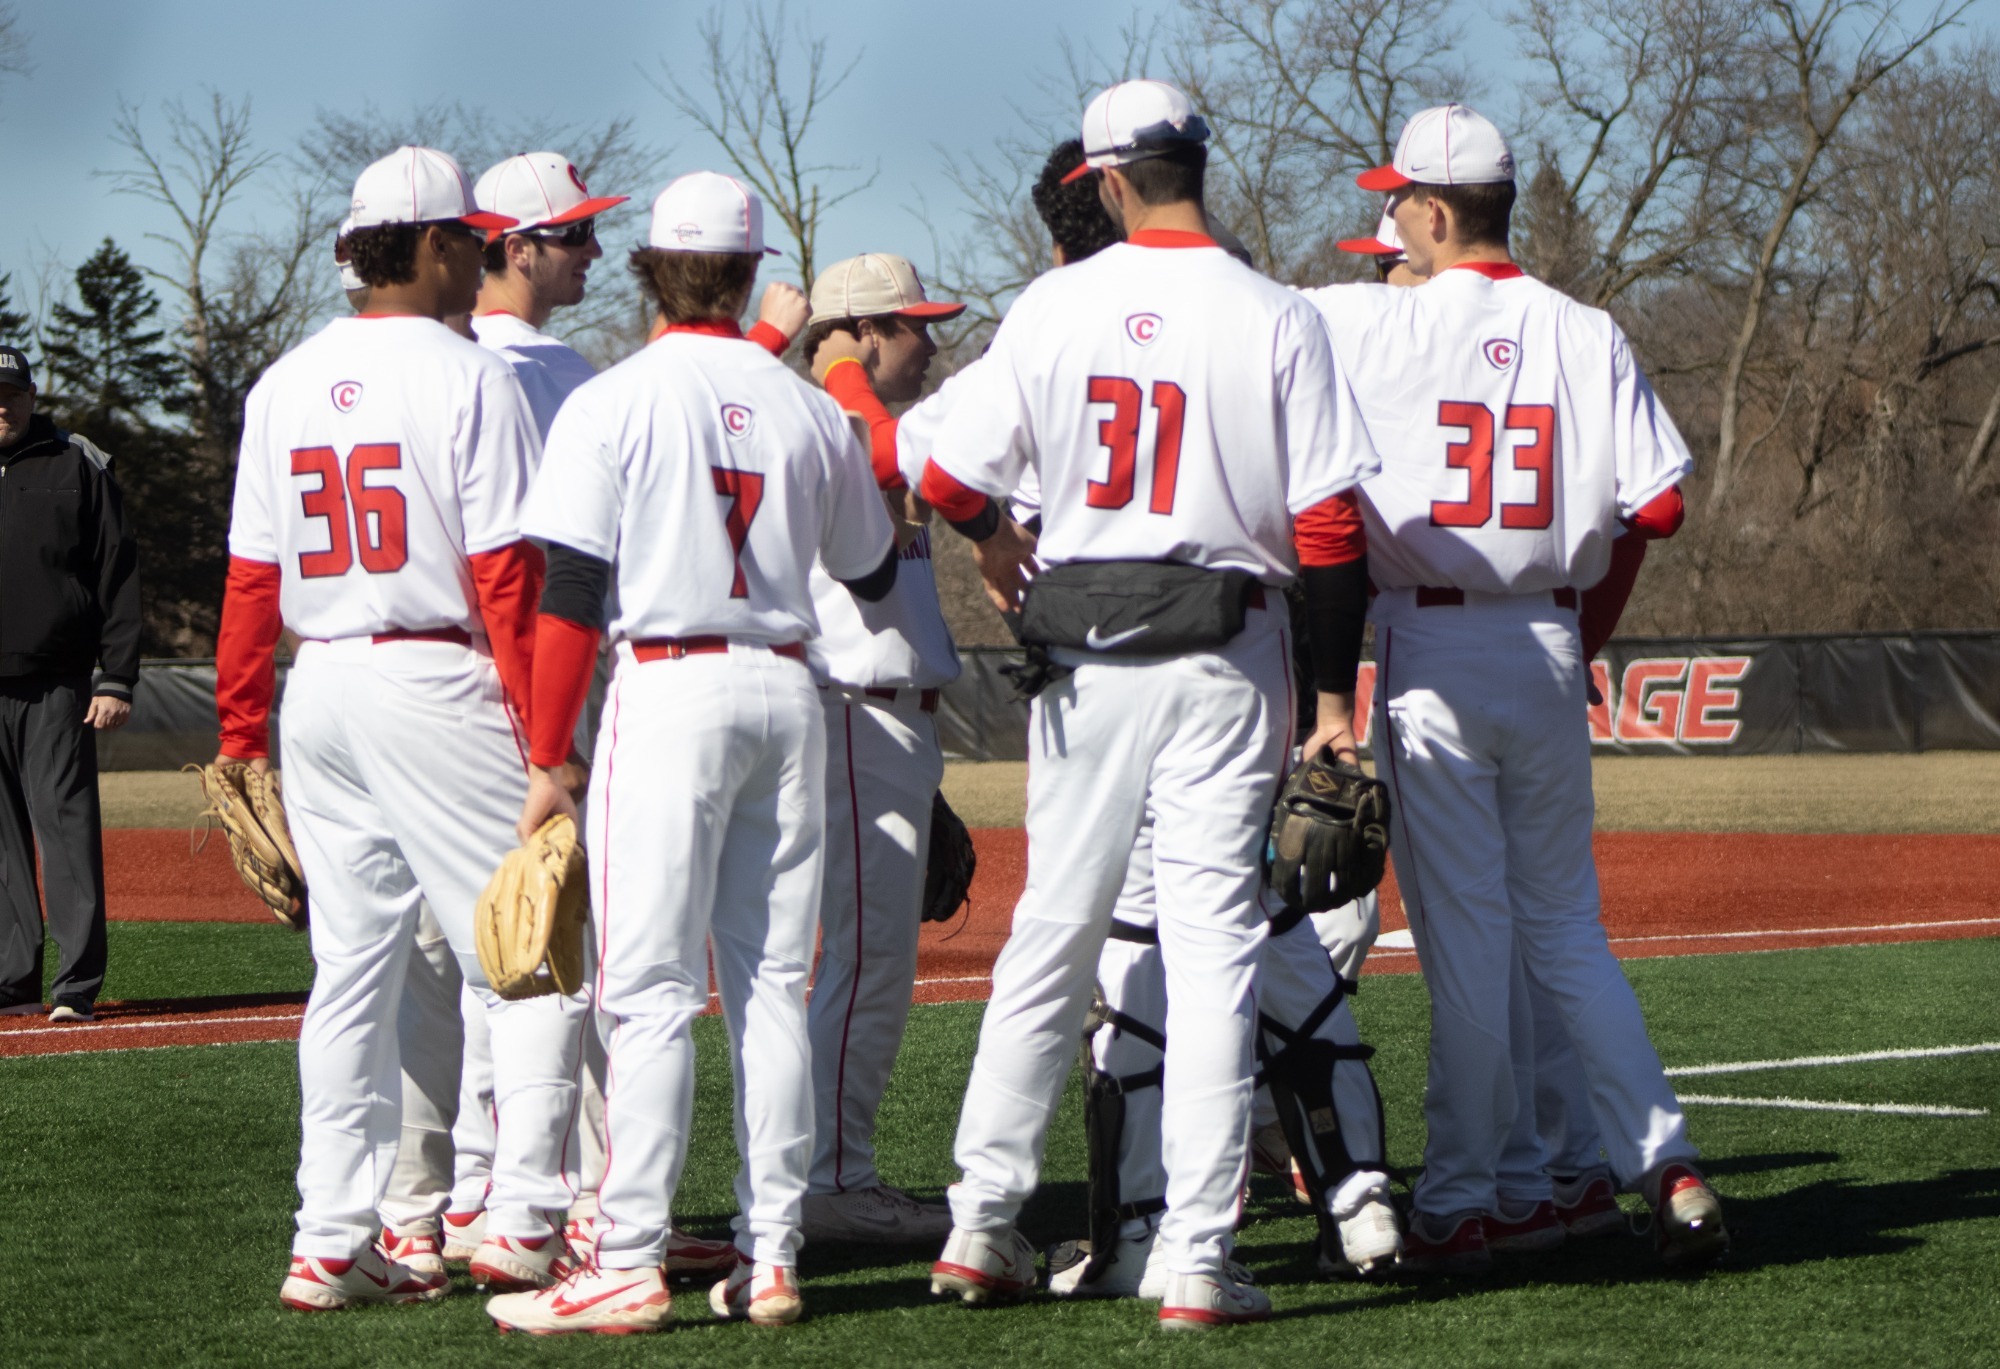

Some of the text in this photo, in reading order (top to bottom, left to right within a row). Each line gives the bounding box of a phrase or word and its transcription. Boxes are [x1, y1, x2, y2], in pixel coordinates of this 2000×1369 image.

[1136, 319, 1154, 340] C
[1493, 344, 1510, 364] C
[340, 387, 355, 407] C
[729, 410, 744, 431] C
[1086, 376, 1187, 516] 31
[1429, 400, 1554, 530] 33
[290, 442, 408, 579] 36
[711, 465, 765, 599] 7
